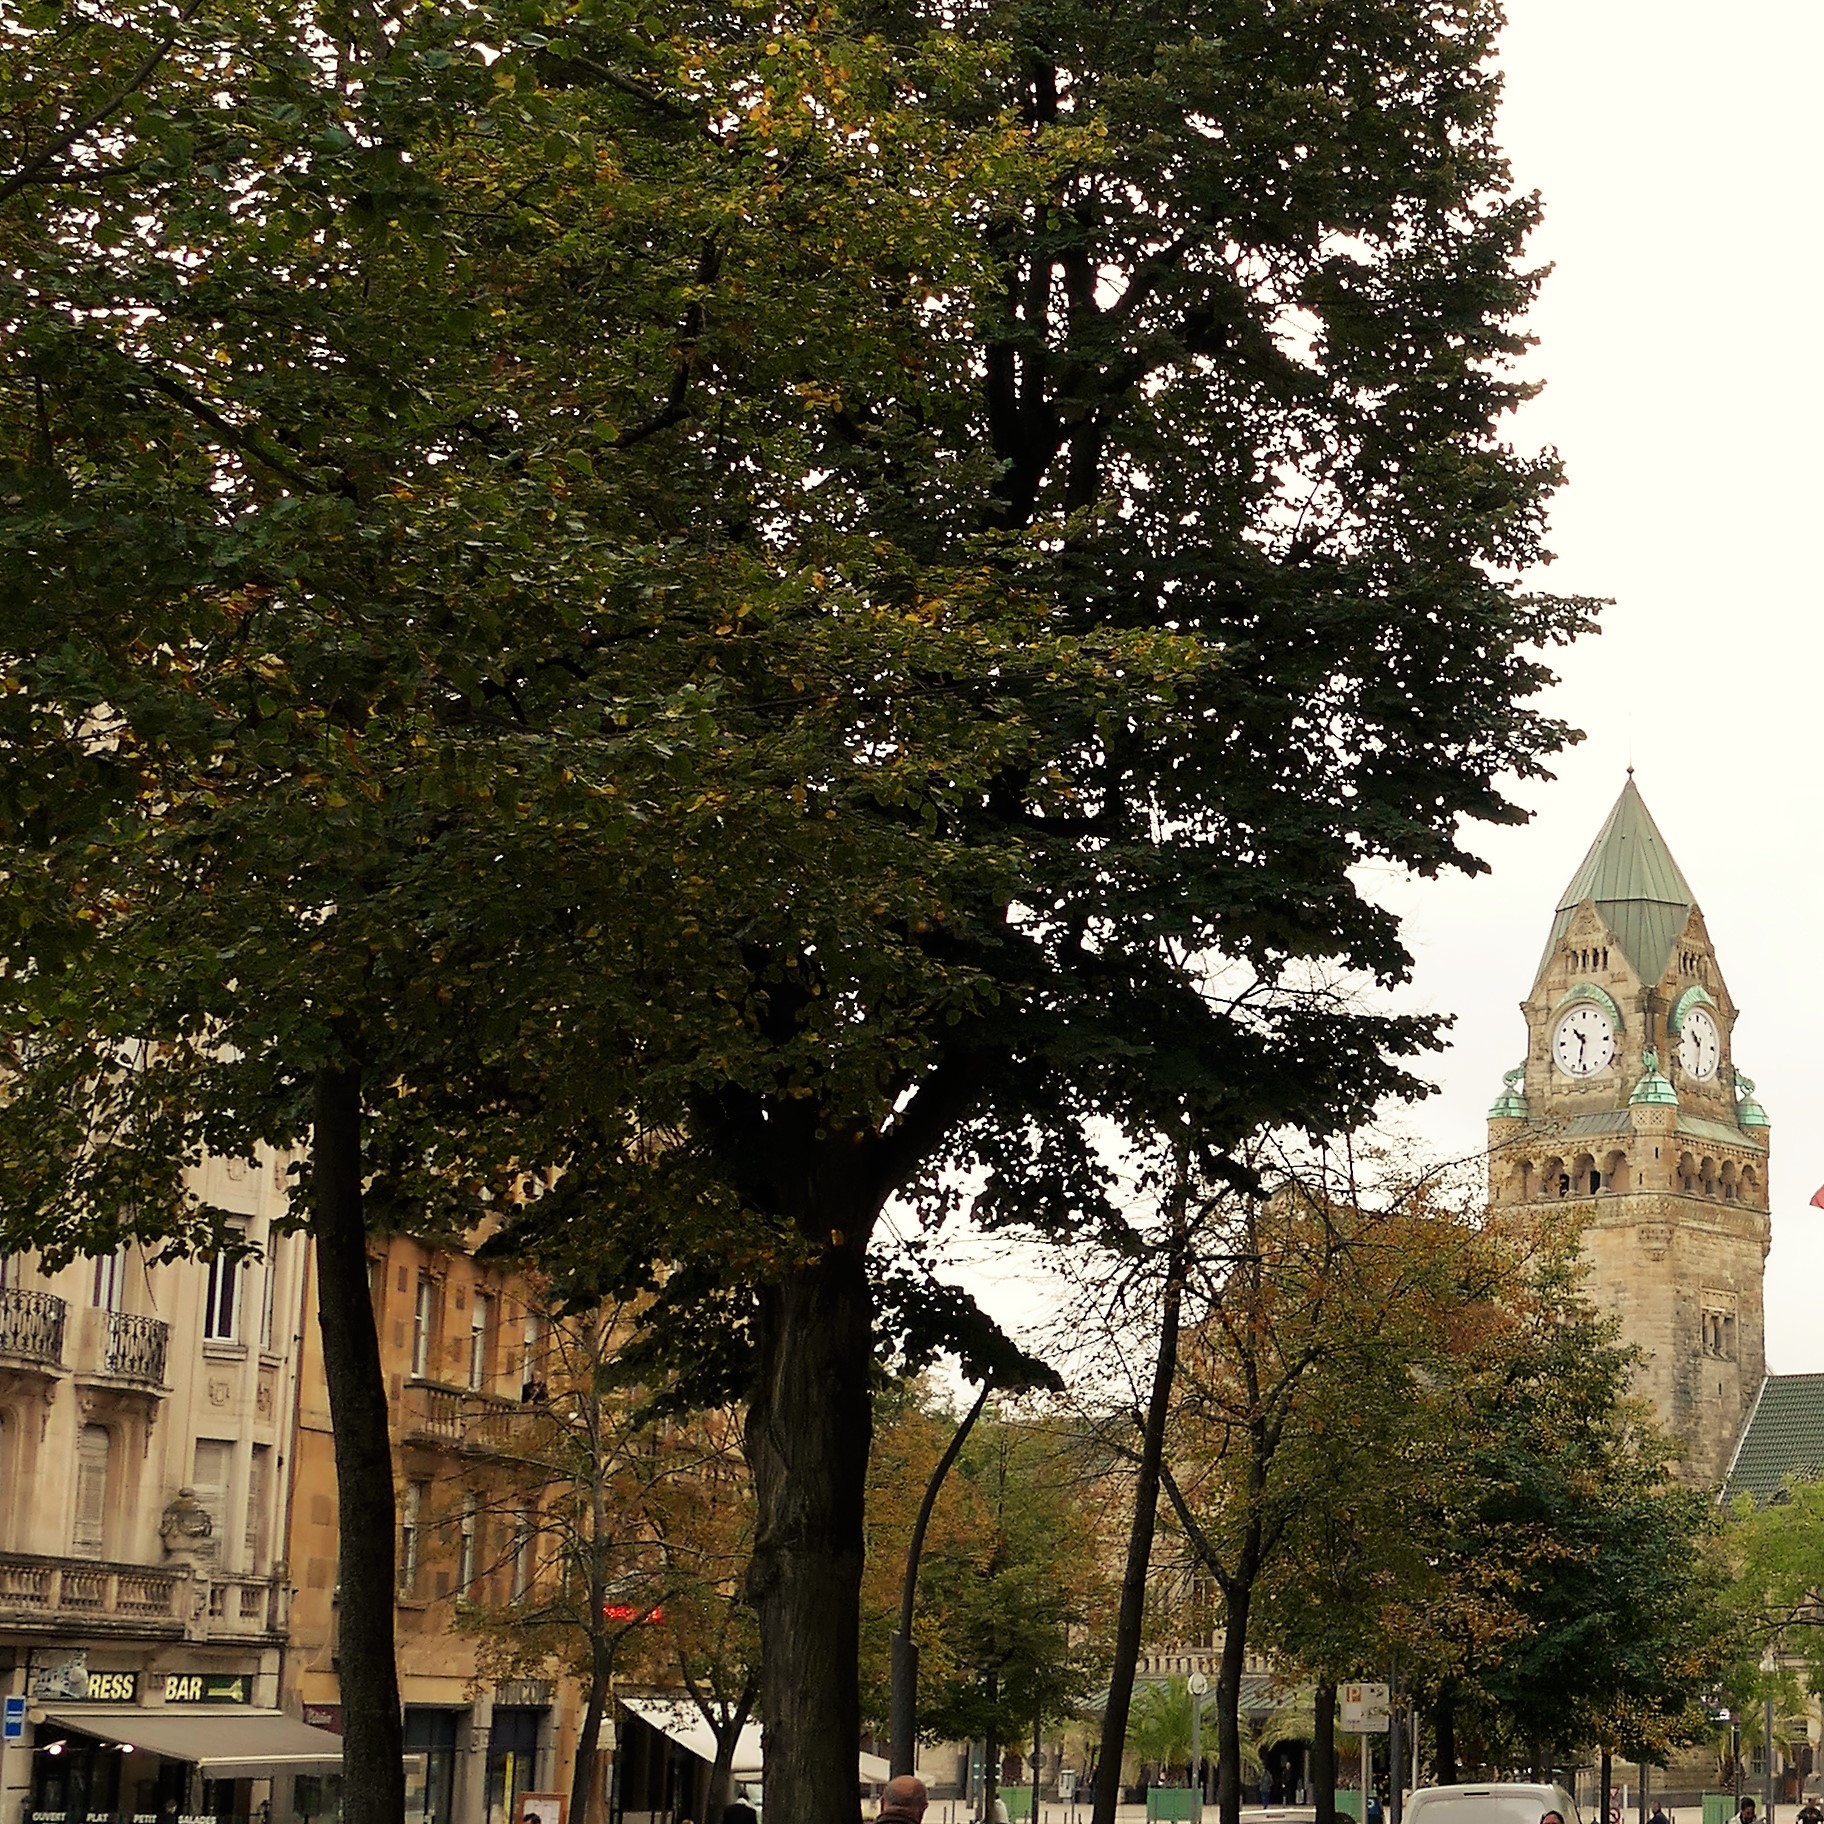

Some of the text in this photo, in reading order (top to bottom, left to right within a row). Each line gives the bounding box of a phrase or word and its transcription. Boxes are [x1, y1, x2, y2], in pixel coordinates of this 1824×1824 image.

[165, 1677, 202, 1700] BAR
[32, 1812, 67, 1821] OUVERT
[86, 1813, 109, 1822] PLAT
[133, 1814, 157, 1823] PETIT
[178, 1815, 217, 1824] SALADES
